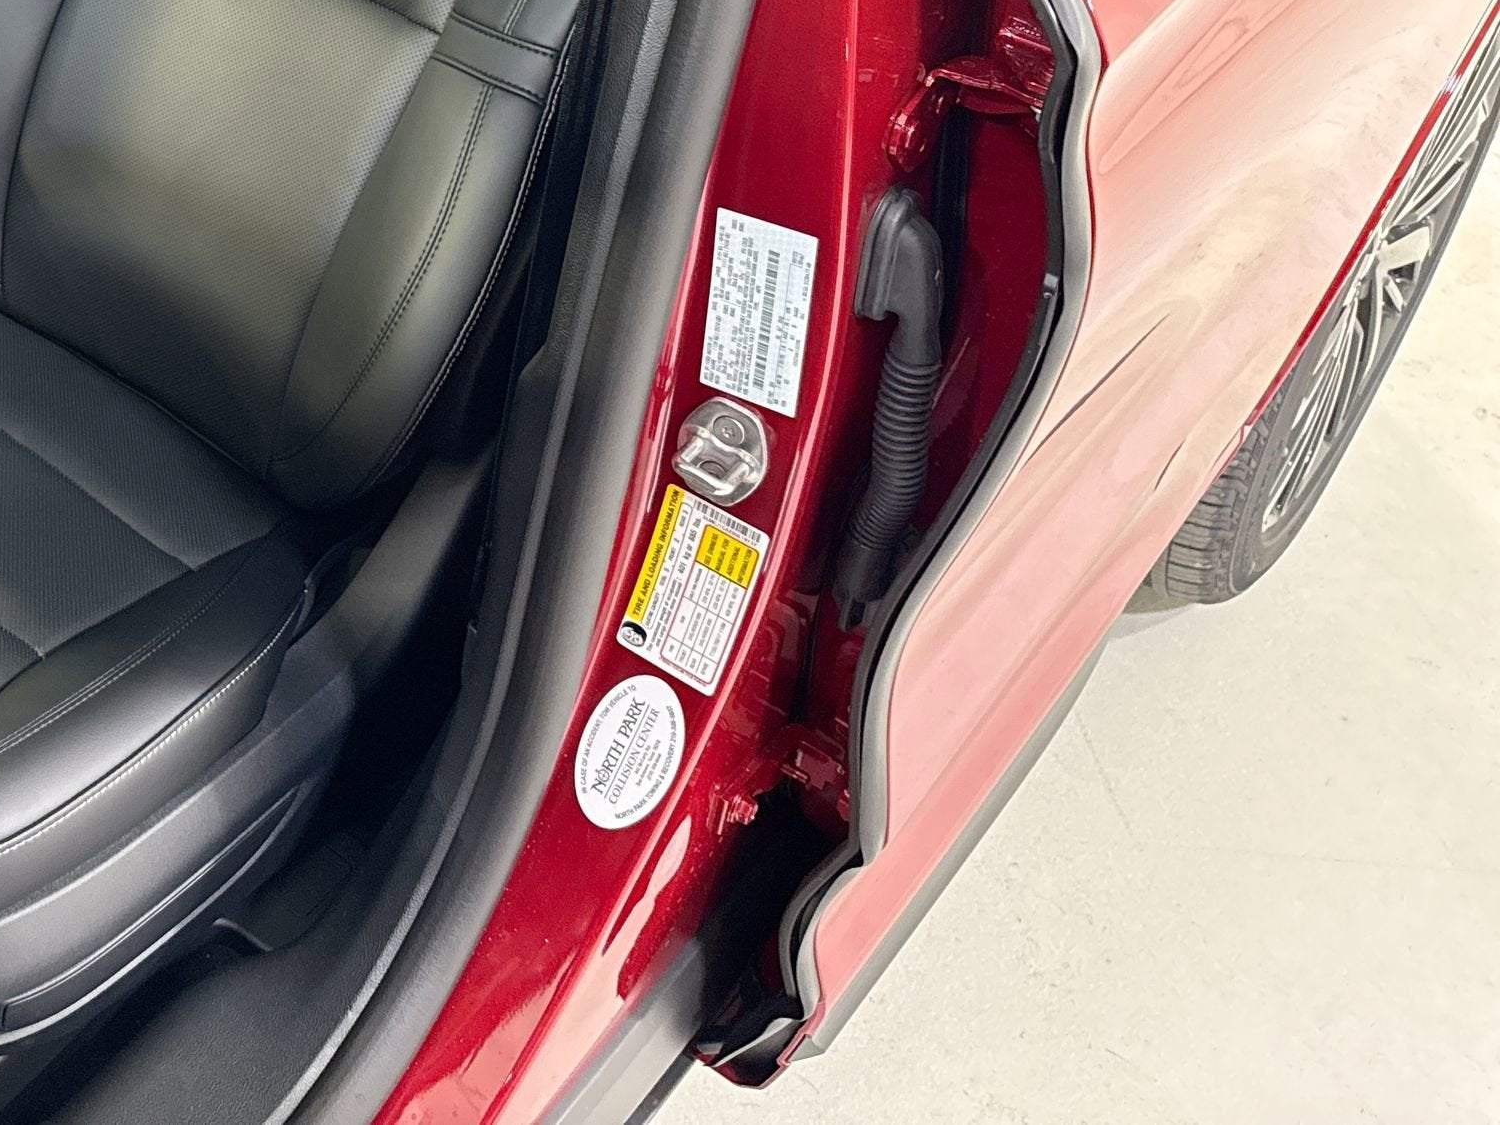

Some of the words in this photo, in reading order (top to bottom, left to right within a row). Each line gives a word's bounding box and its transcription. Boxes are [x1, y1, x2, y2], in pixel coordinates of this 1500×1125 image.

[632, 597, 645, 616] TIRE
[639, 578, 651, 597] AND
[647, 543, 662, 579] LOADING
[661, 489, 680, 542] INFORMATION
[677, 561, 687, 574] 401
[627, 684, 637, 692] TO
[608, 689, 629, 708] VEHICLE
[583, 748, 591, 758] AN
[590, 739, 622, 795] NORTH
[617, 697, 646, 739] PARK
[581, 757, 588, 767] OF
[608, 748, 641, 805] COLLISION
[635, 708, 660, 749] CENTER
[614, 808, 635, 819] NORTH
[633, 798, 648, 812] PARK
[645, 778, 662, 800] TOWING
[660, 742, 675, 775] RECOVERY
[581, 786, 588, 794] IN
